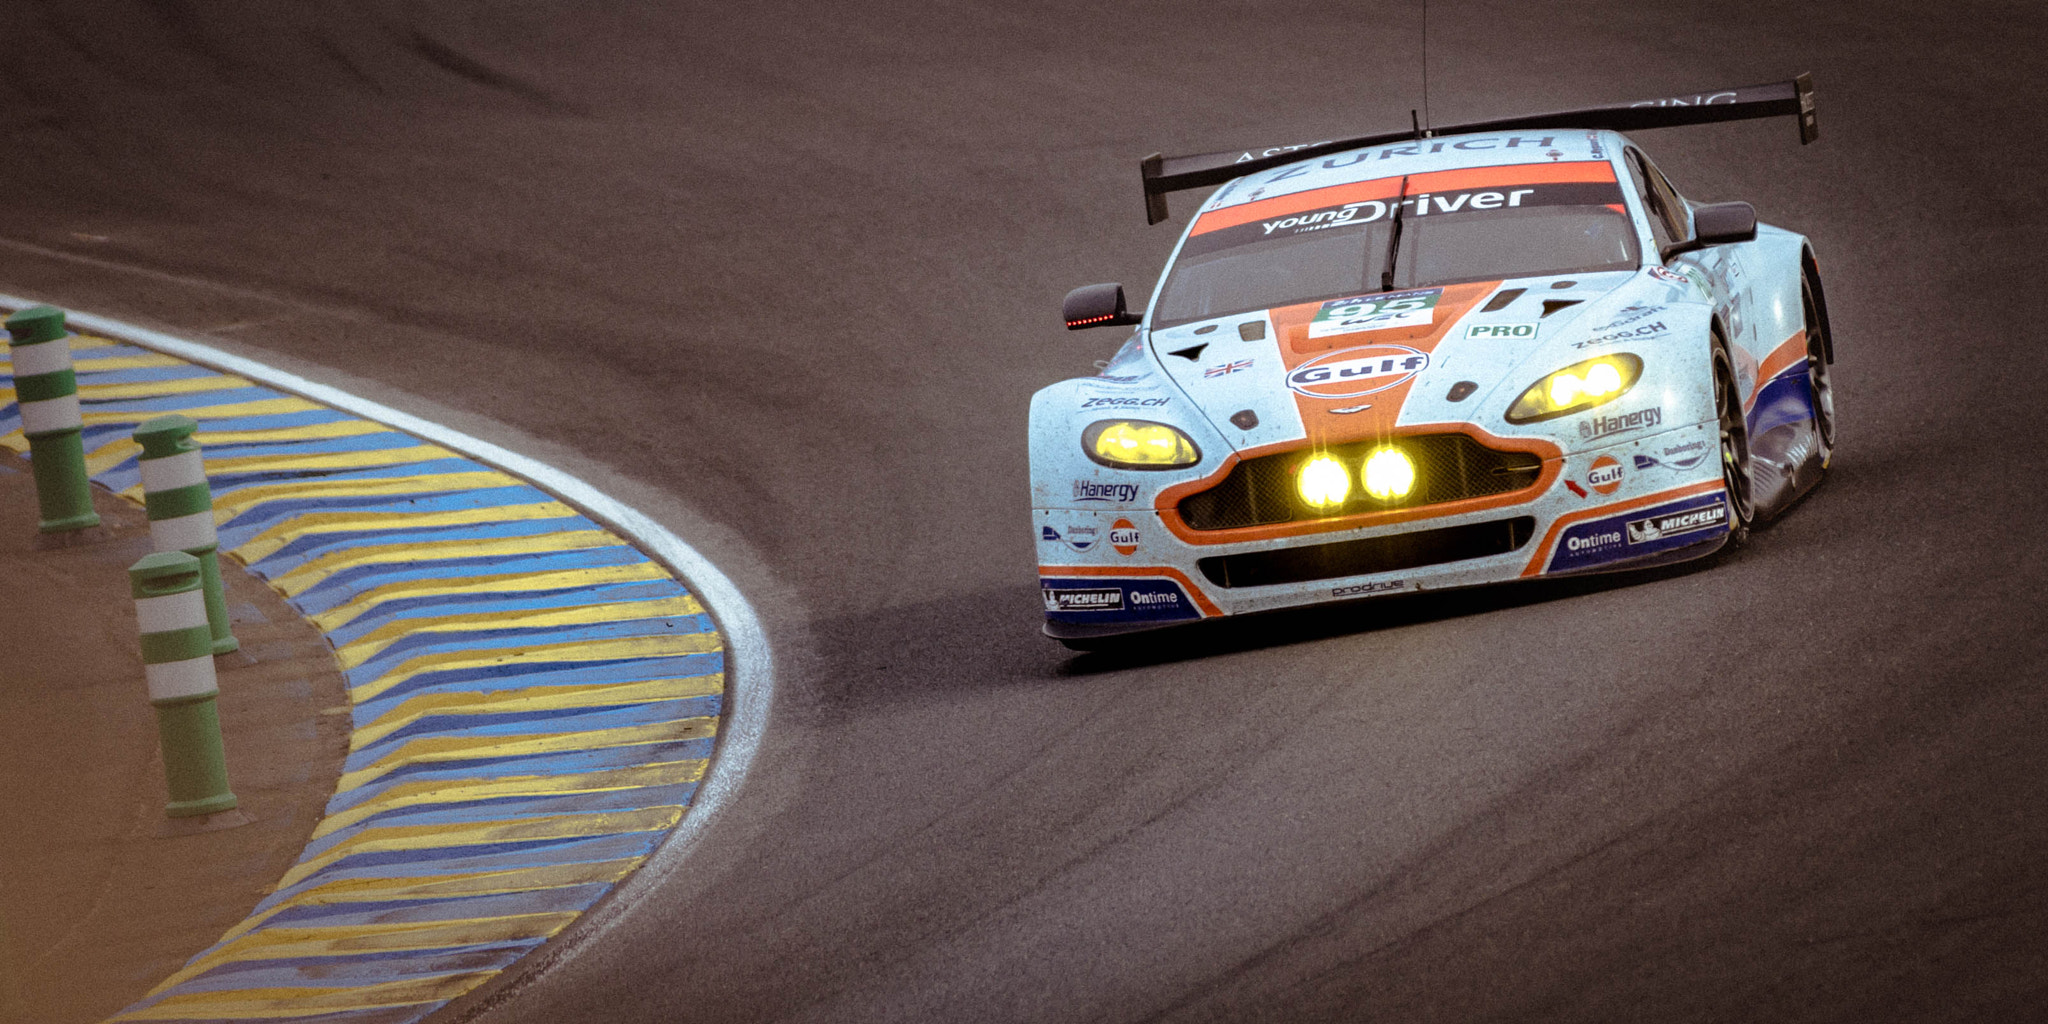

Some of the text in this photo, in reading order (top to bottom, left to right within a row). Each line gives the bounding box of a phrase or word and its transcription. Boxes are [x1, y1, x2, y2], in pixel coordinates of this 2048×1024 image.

[1265, 136, 1555, 184] ZURICH
[1263, 189, 1535, 235] young Driver
[1328, 297, 1426, 320] 95
[1471, 325, 1533, 338] PRO
[1290, 354, 1428, 384] Gulf
[1594, 406, 1662, 436] Hanergy
[1588, 467, 1624, 484] Gulf
[1080, 480, 1139, 501] Hanergy
[1660, 506, 1725, 530] MICHELIN
[1110, 531, 1140, 544] Gulf
[1567, 531, 1621, 551] Ontime
[1130, 591, 1178, 605] Ontime
[1332, 580, 1404, 597] prodrive
[1059, 592, 1121, 606] MICHELIN
